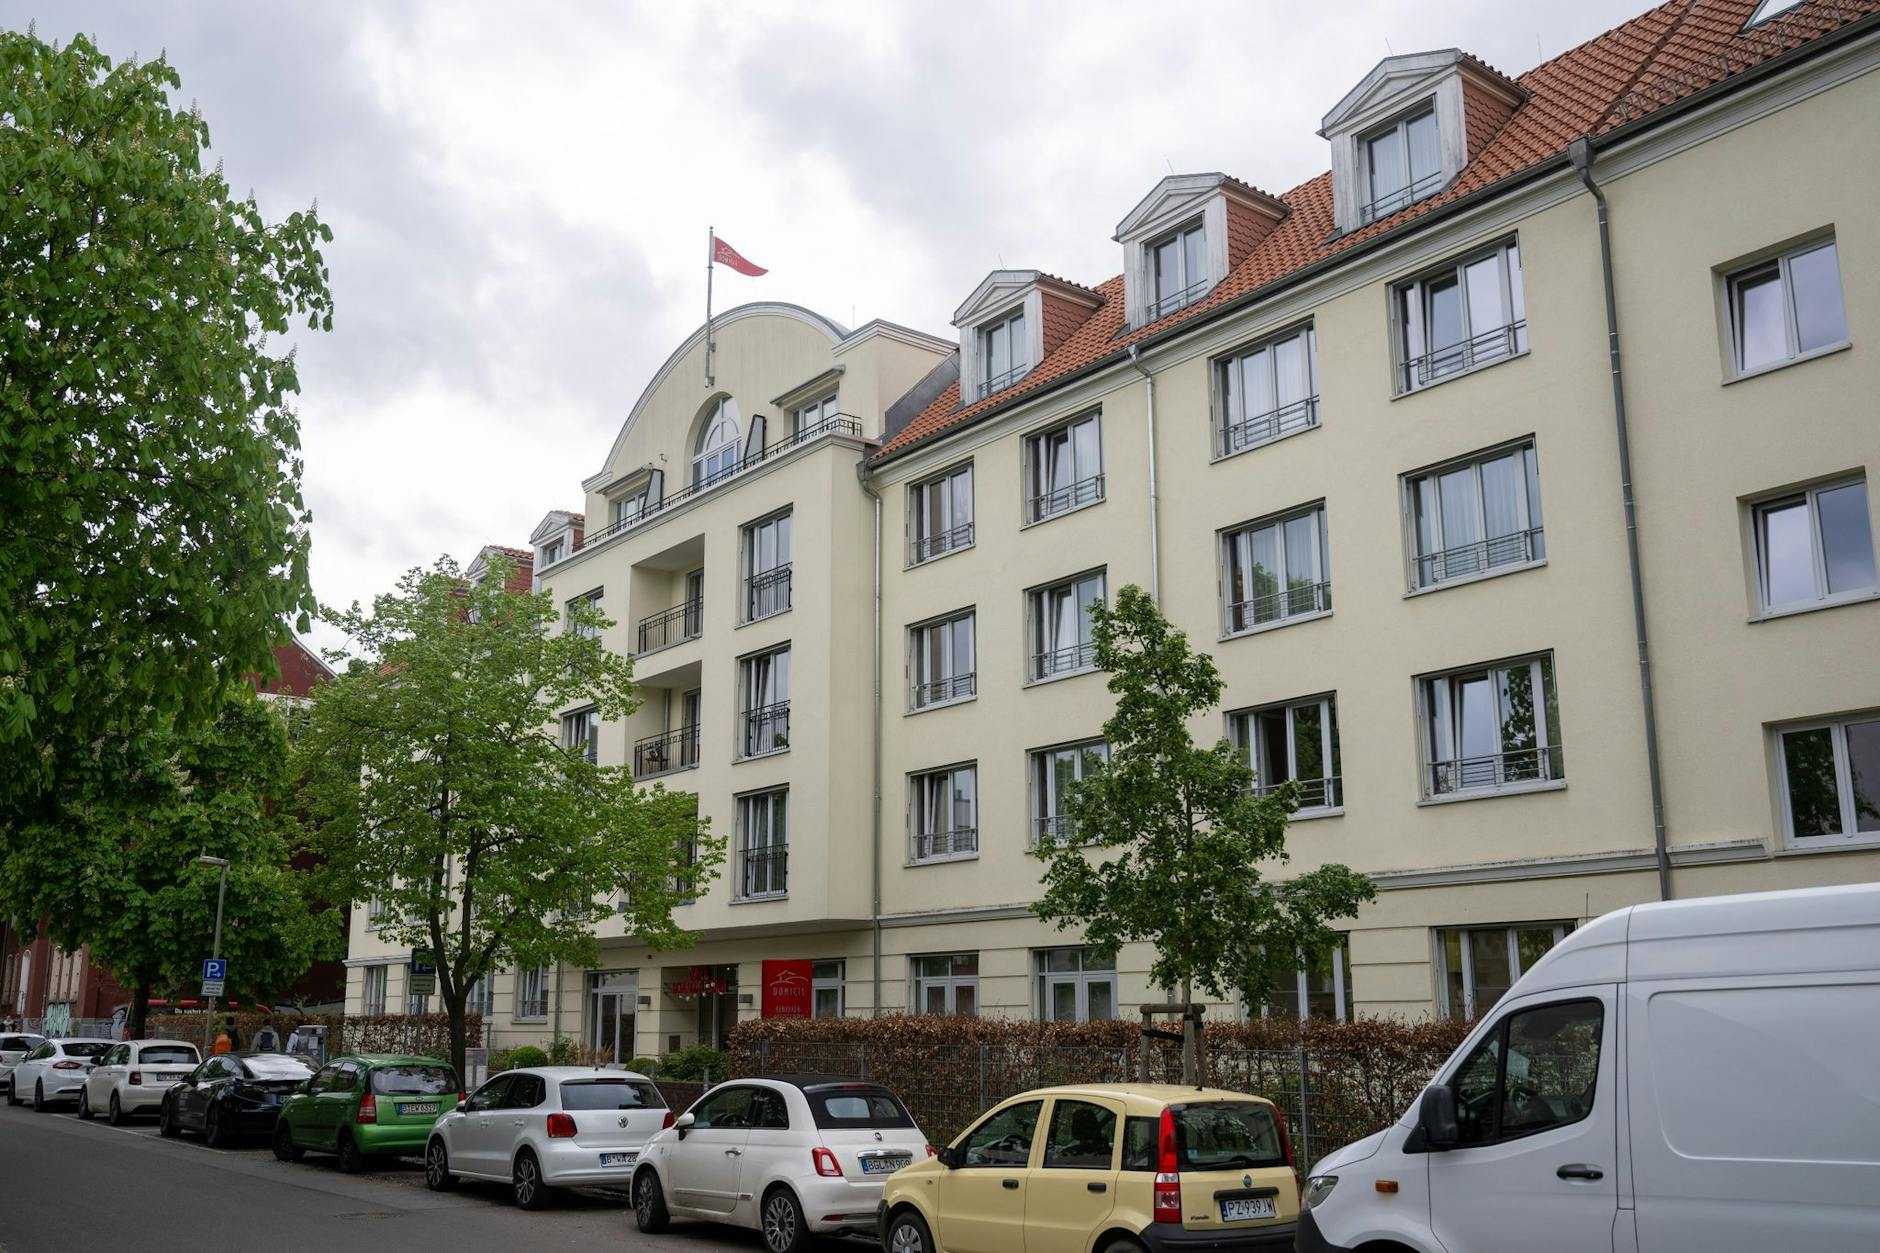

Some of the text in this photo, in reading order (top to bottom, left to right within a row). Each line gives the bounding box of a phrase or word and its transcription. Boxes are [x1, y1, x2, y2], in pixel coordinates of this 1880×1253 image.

[206, 962, 220, 977] P
[772, 987, 806, 997] DOMICIL
[868, 1160, 885, 1170] BGL
[889, 1159, 896, 1169] N
[1227, 1201, 1243, 1216] PZ
